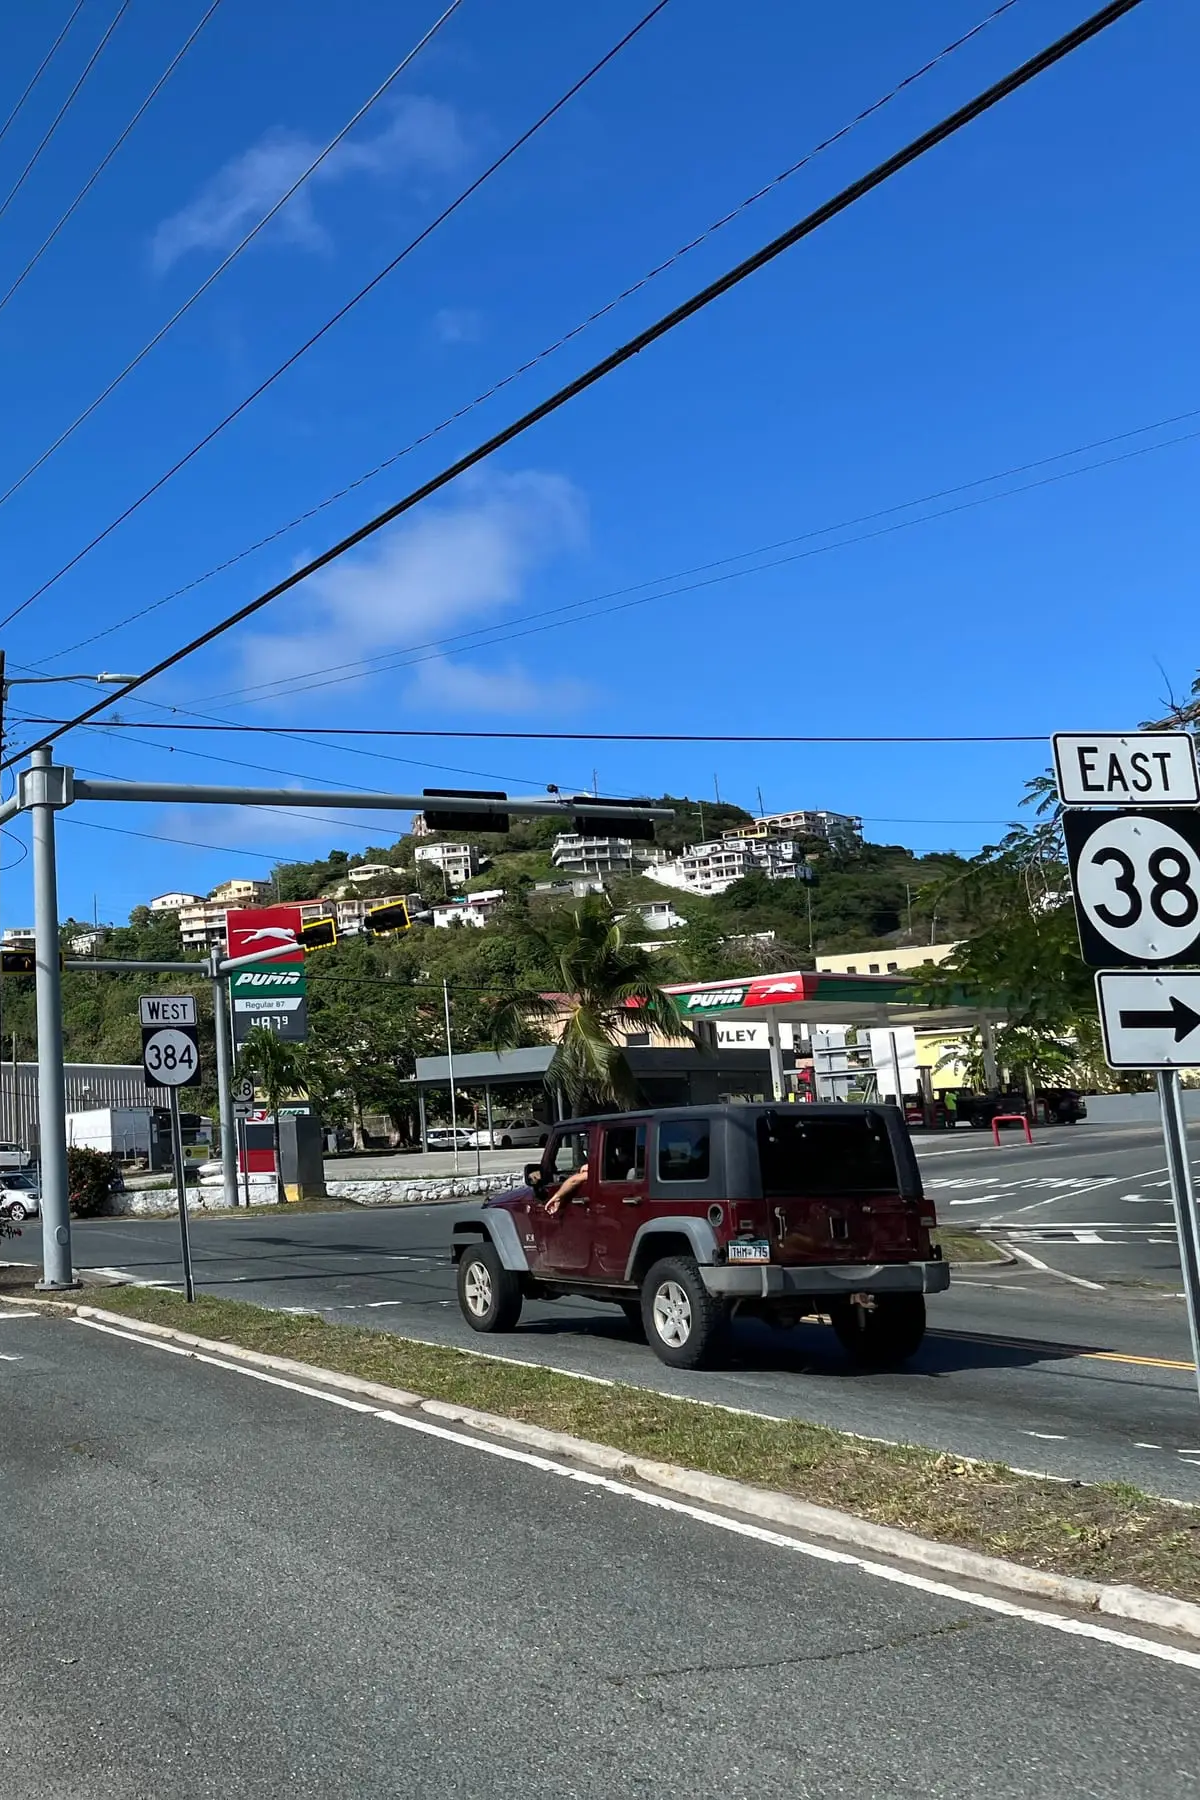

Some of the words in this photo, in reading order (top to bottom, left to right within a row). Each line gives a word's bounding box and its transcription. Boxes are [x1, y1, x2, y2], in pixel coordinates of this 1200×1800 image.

[1077, 746, 1171, 792] EAST
[1091, 846, 1198, 929] 38
[234, 971, 301, 986] PUMA
[245, 1002, 274, 1010] Regular
[687, 988, 743, 1009] PUMA
[147, 1001, 188, 1020] WEST
[148, 1044, 194, 1070] 384
